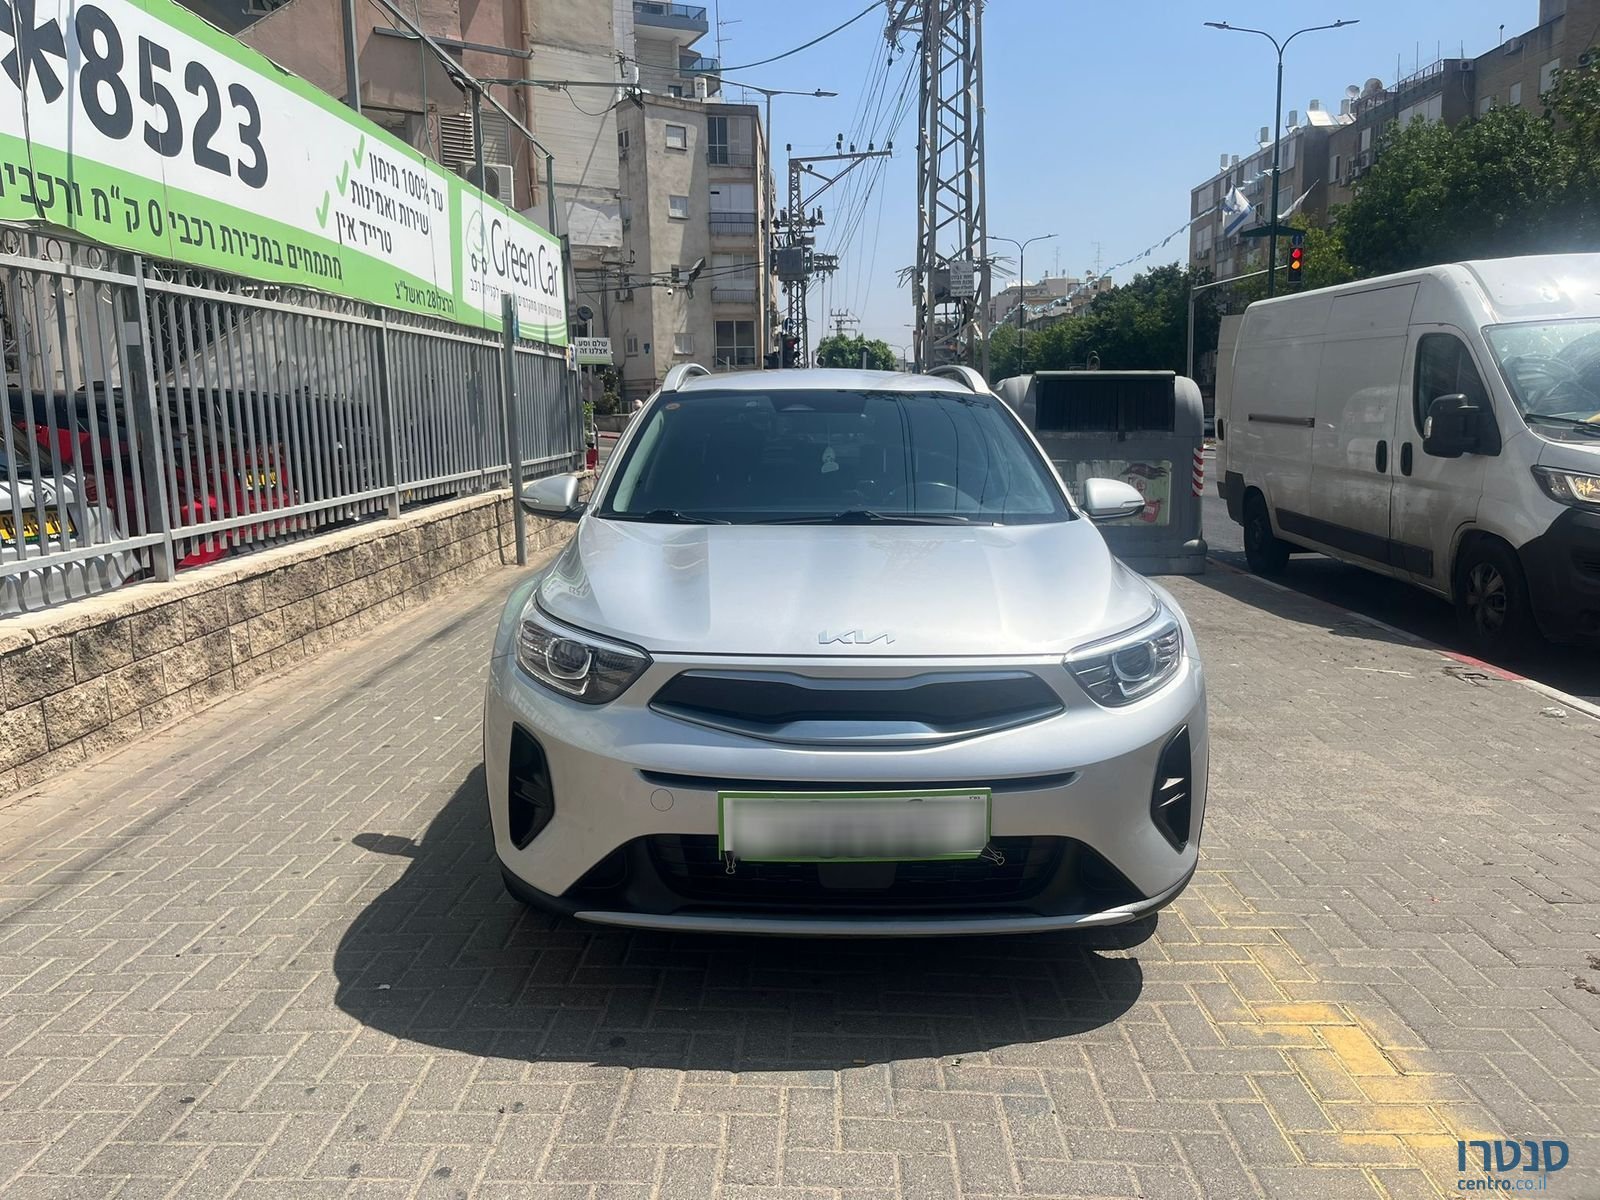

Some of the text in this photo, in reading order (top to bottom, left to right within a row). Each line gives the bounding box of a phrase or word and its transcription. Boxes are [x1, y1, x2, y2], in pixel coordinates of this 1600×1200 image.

[0, 160, 83, 217] ורכבי
[369, 152, 444, 213] עד 100% מימון
[147, 199, 163, 237] 0
[350, 179, 429, 236] שירות ואמינות
[168, 210, 216, 250] רכבי
[219, 224, 284, 266] במכירת
[336, 211, 393, 254] טרייד אין
[286, 243, 343, 280] מתמחים
[491, 218, 559, 298] Green Car
[818, 629, 896, 645] KIA
